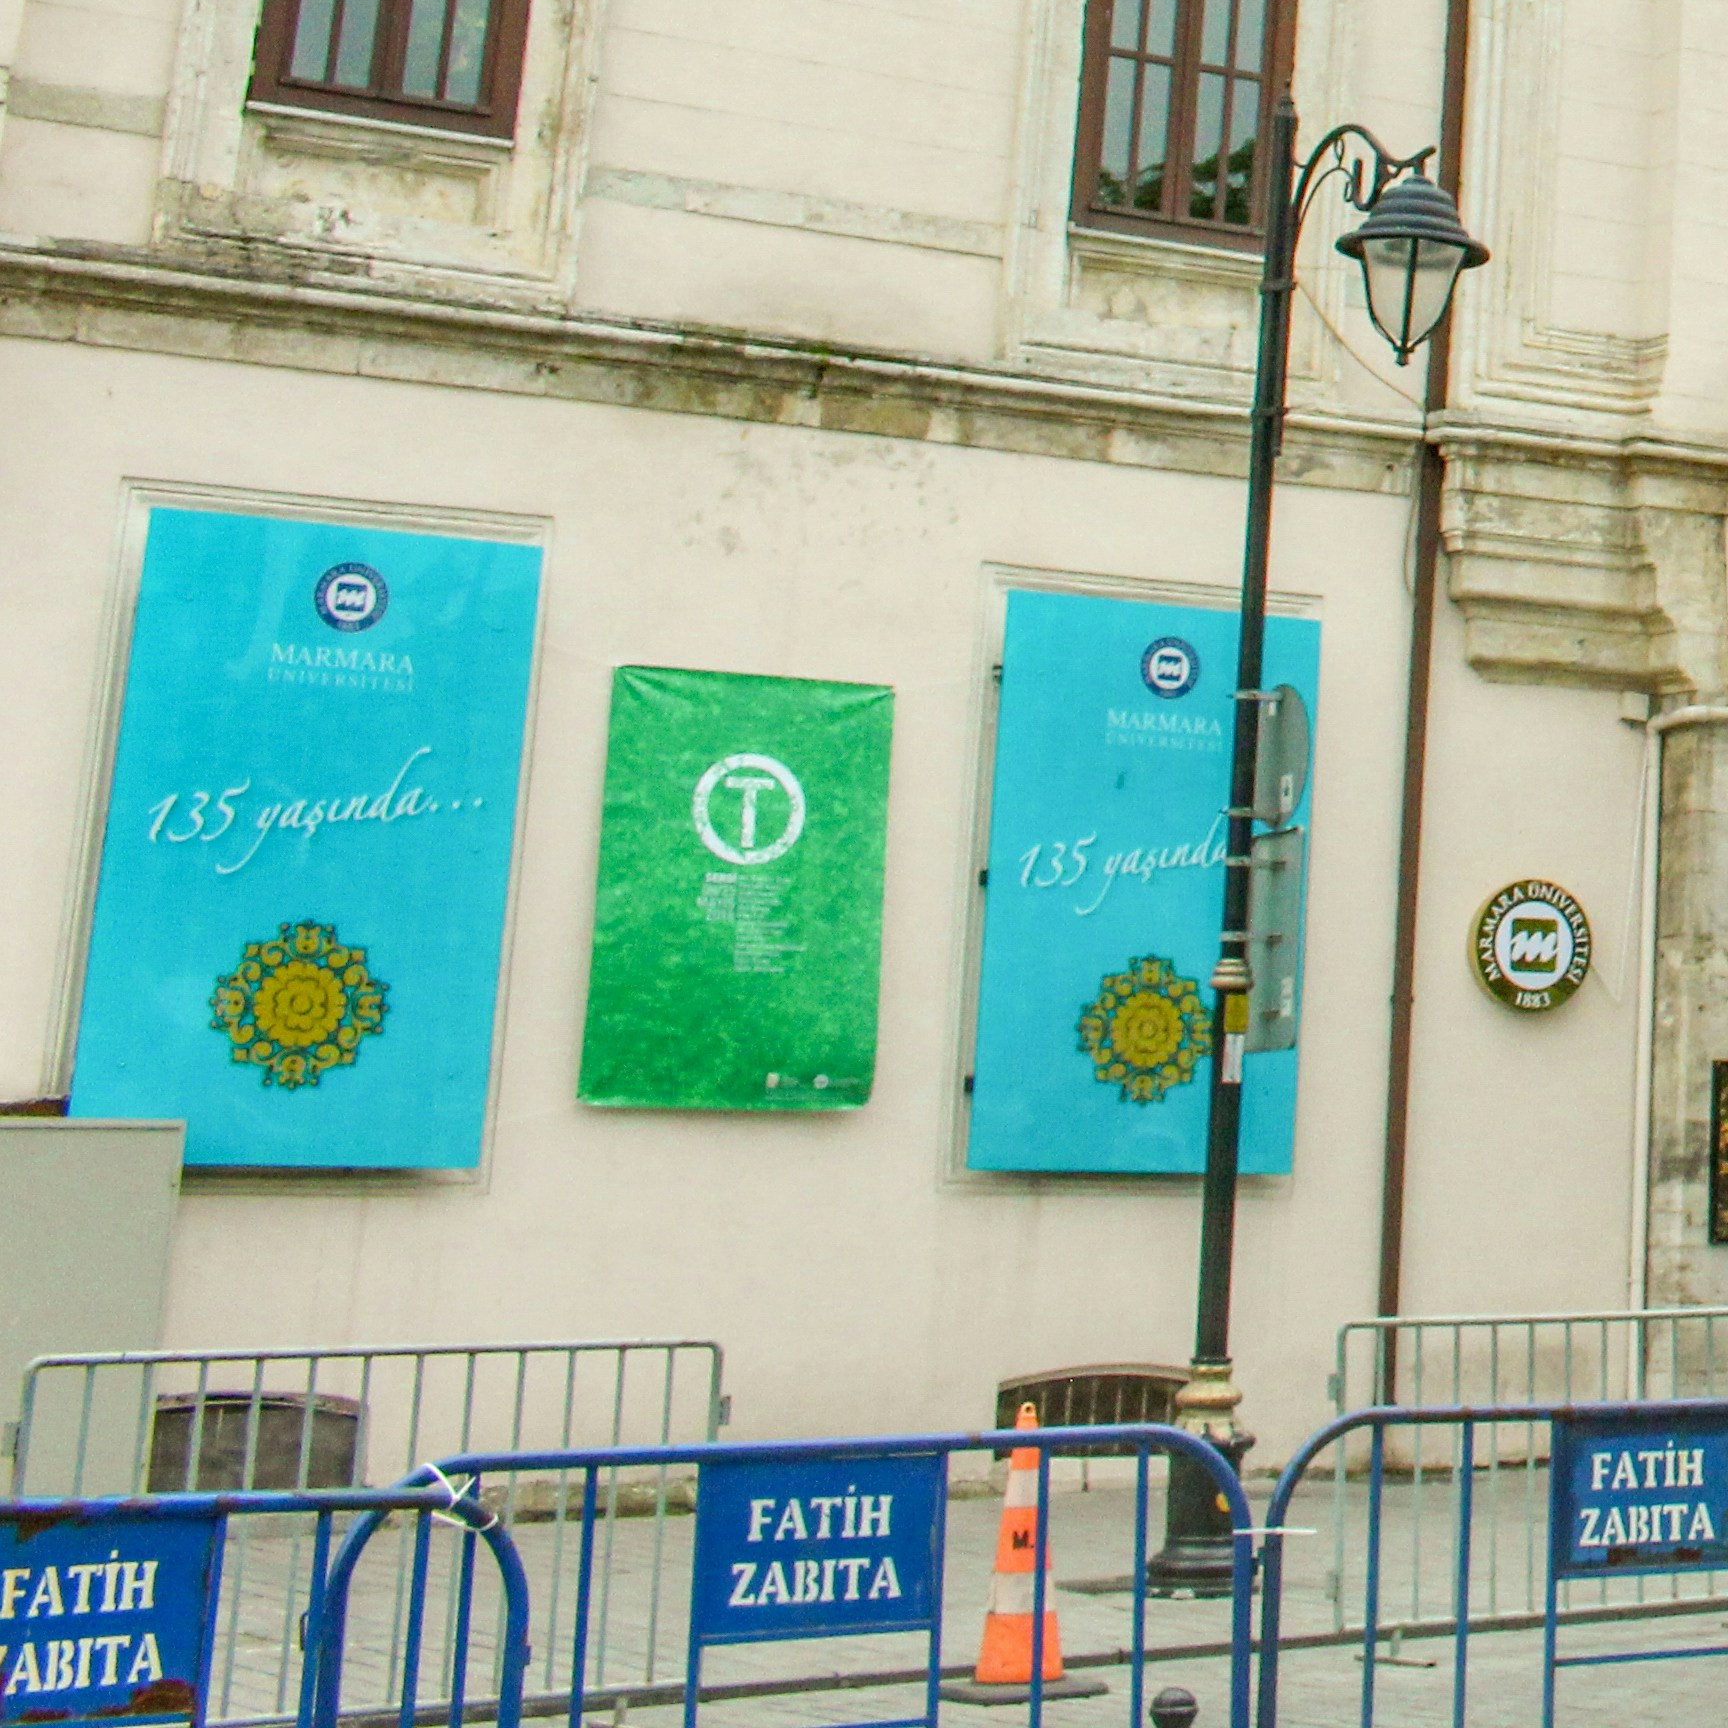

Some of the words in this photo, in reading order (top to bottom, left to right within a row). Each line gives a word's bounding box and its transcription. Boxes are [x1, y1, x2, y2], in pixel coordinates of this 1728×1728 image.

[271, 642, 414, 674] MARMARA
[1106, 707, 1222, 737] MARMARA
[149, 776, 250, 844] 135
[725, 775, 775, 848] T
[1019, 830, 1097, 888] 135
[1480, 886, 1526, 981] MARMARA
[1591, 1439, 1704, 1491] FATİH
[747, 1485, 893, 1542] FATİH
[1578, 1502, 1715, 1547] ZABITA
[0, 1549, 158, 1619] FATİH
[728, 1556, 902, 1607] ZABITA
[0, 1633, 163, 1695] ABITA
